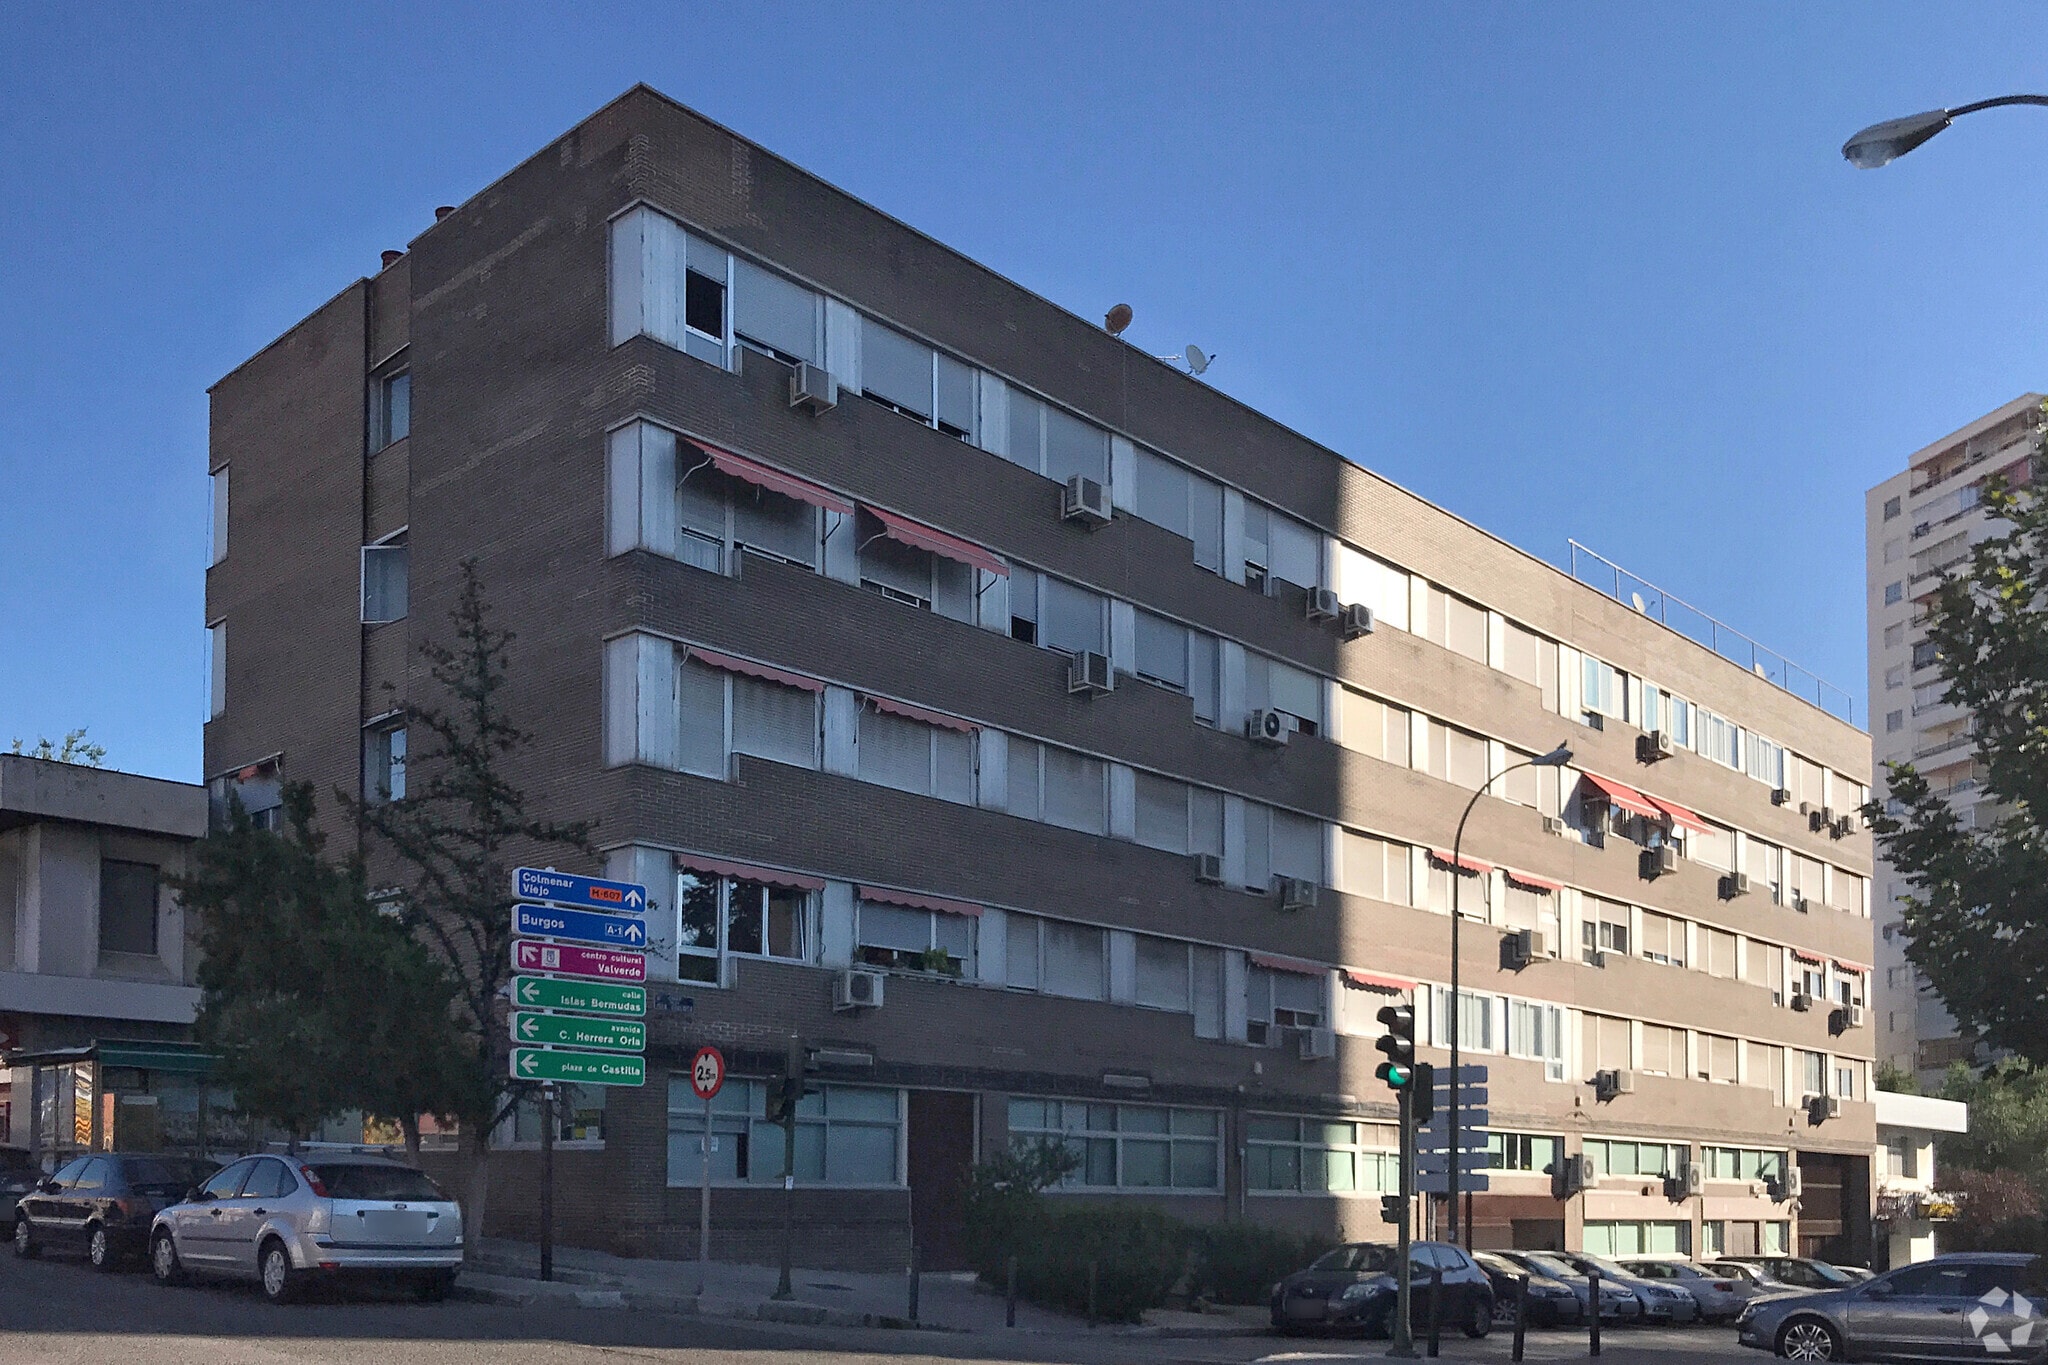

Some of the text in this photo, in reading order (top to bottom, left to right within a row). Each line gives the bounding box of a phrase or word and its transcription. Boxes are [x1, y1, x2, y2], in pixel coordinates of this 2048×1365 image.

[522, 872, 574, 888] Colmenar
[522, 883, 549, 897] Viejo
[521, 914, 565, 929] Burgos
[607, 925, 622, 935] A-1
[581, 952, 642, 965] centro cultural
[598, 964, 641, 977] Valverde
[622, 991, 641, 1000] calle
[561, 995, 641, 1012] Islas Bermudas
[611, 1025, 641, 1034] avenida
[559, 1030, 641, 1046] C. Herrera Oria
[561, 1063, 641, 1076] plaza de Castilla
